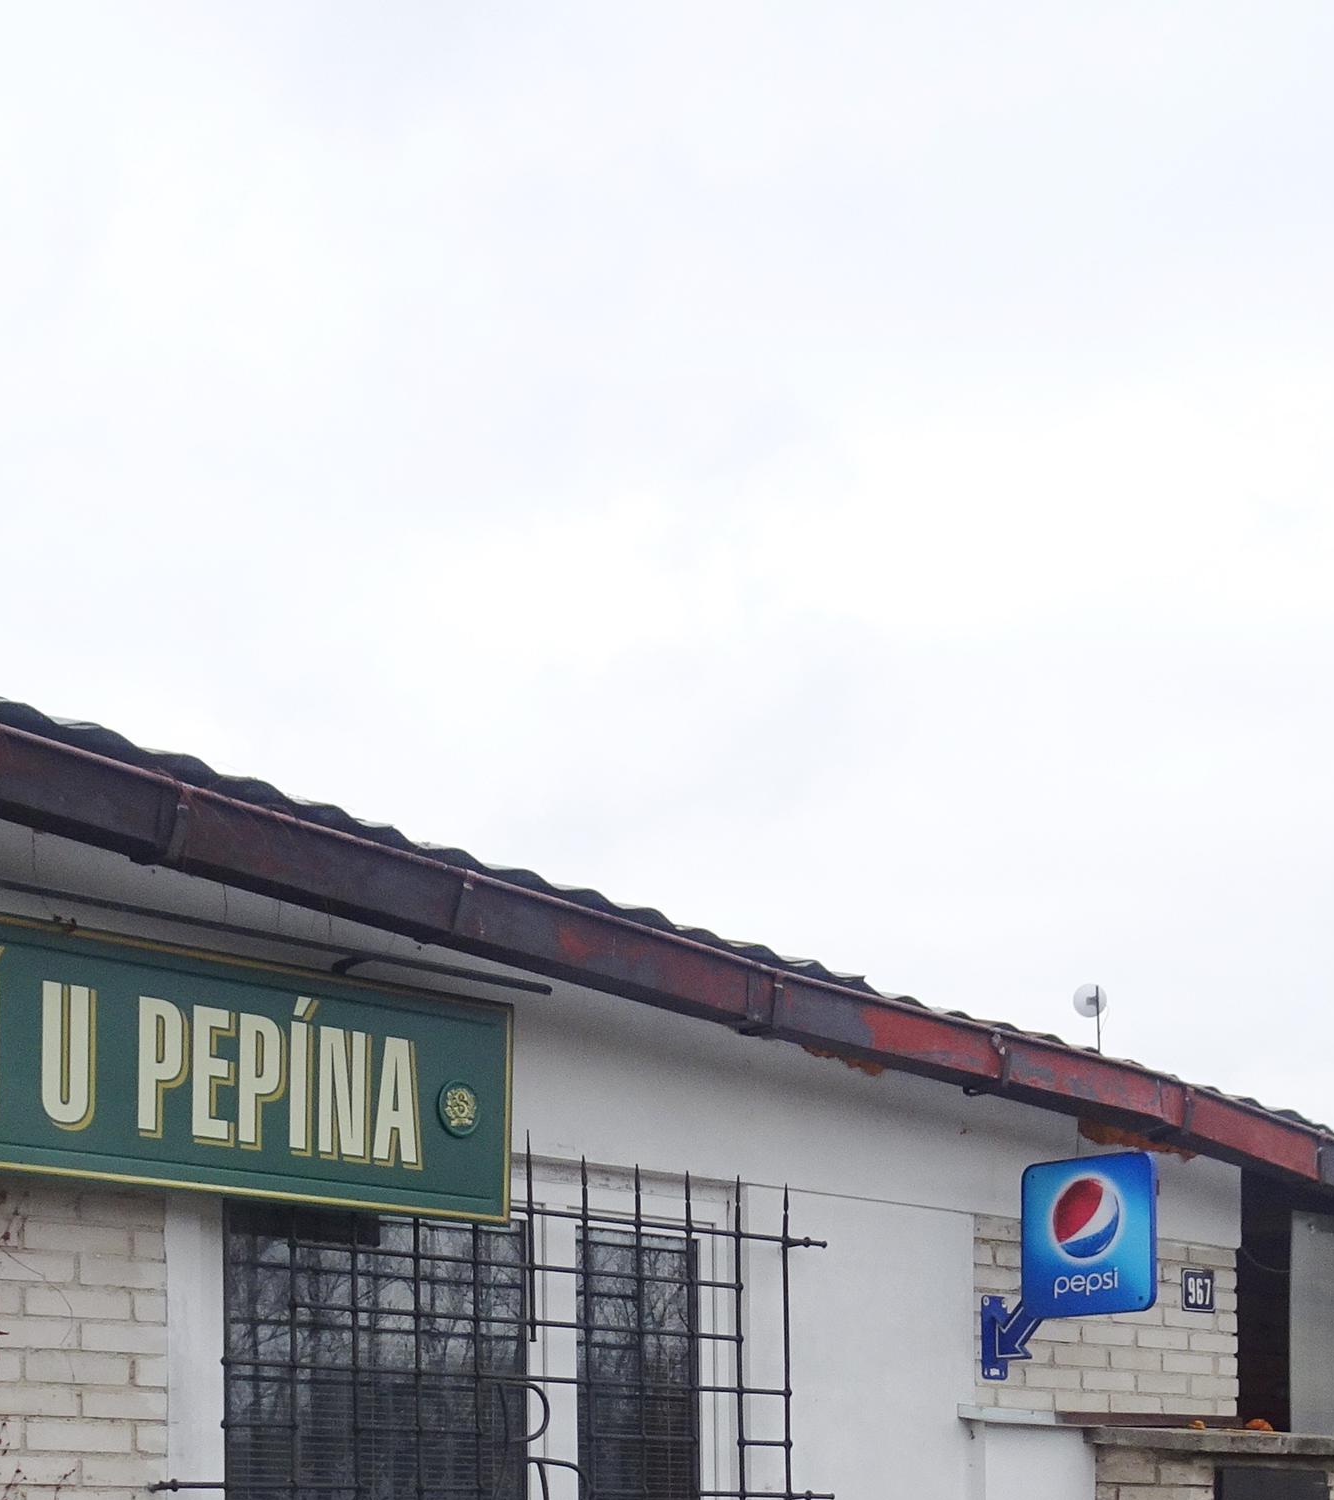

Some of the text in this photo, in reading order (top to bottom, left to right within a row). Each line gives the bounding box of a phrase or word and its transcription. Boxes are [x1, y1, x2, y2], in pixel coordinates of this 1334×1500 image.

[42, 980, 97, 1131] U
[138, 996, 423, 1170] PEPÍNA
[1053, 1266, 1119, 1299] pepsi
[1187, 1276, 1212, 1305] 967
